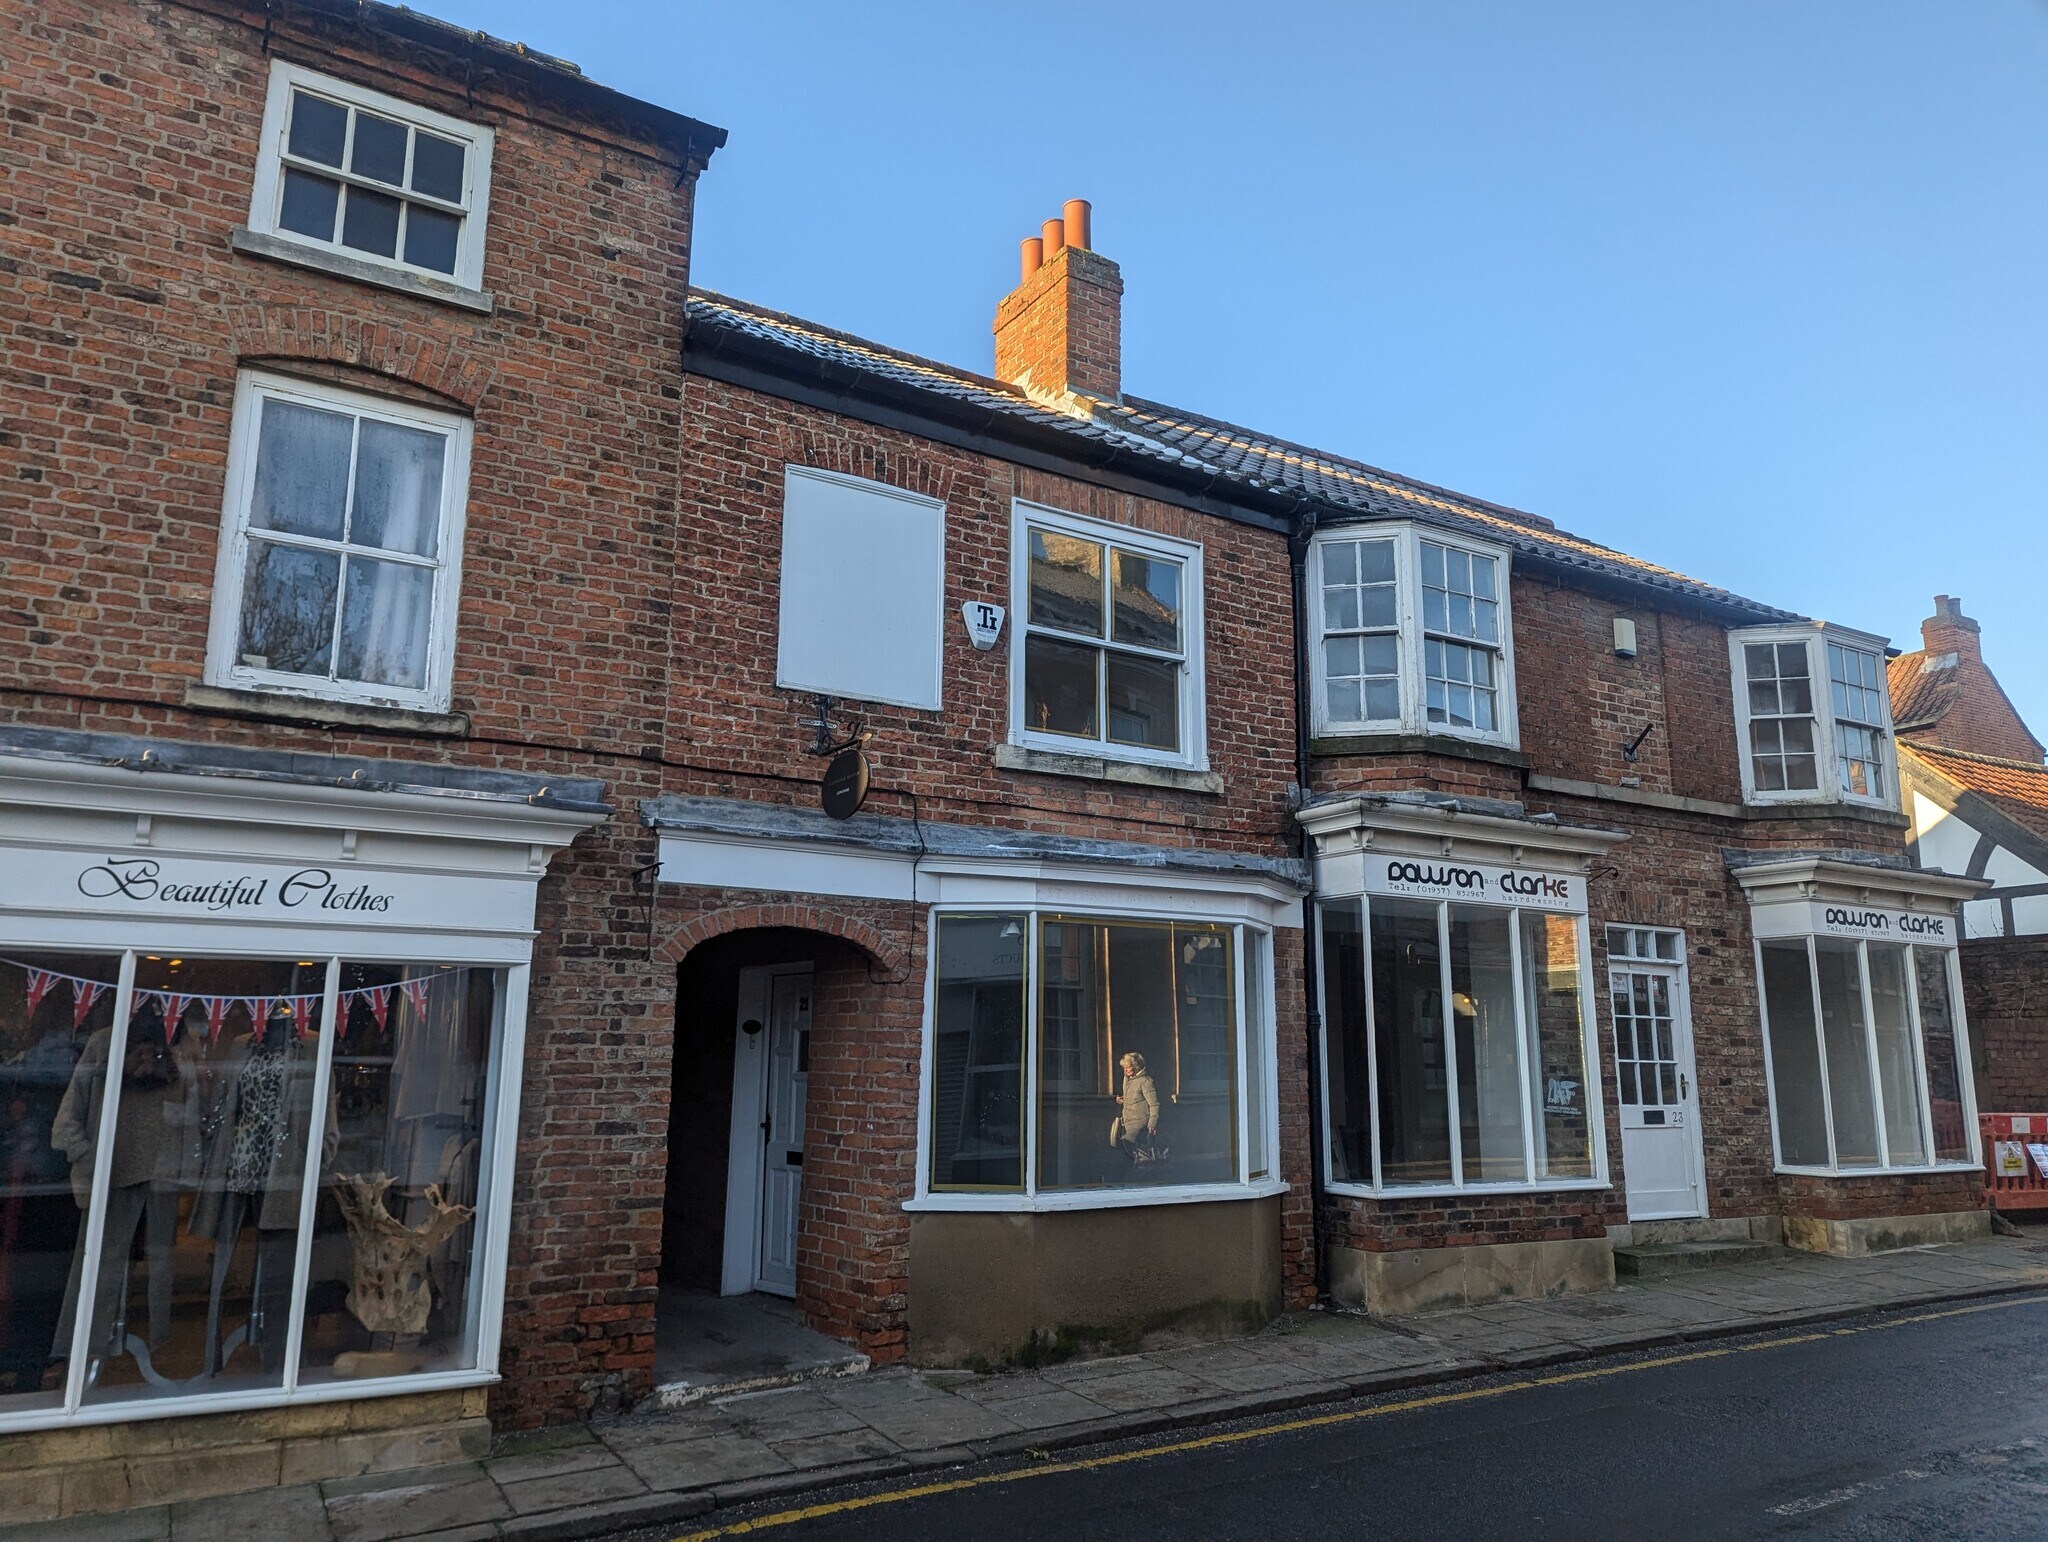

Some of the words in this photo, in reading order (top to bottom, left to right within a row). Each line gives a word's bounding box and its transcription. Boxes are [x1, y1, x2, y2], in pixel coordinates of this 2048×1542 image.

[77, 857, 268, 911] Beautiful
[279, 869, 394, 912] Clothes
[1388, 882, 1411, 892] Tel:
[1417, 886, 1451, 896] (01937)
[1485, 878, 1499, 886] and
[1501, 894, 1569, 908] hairdressing
[799, 997, 809, 1011] 21
[1672, 1111, 1684, 1123] 23
